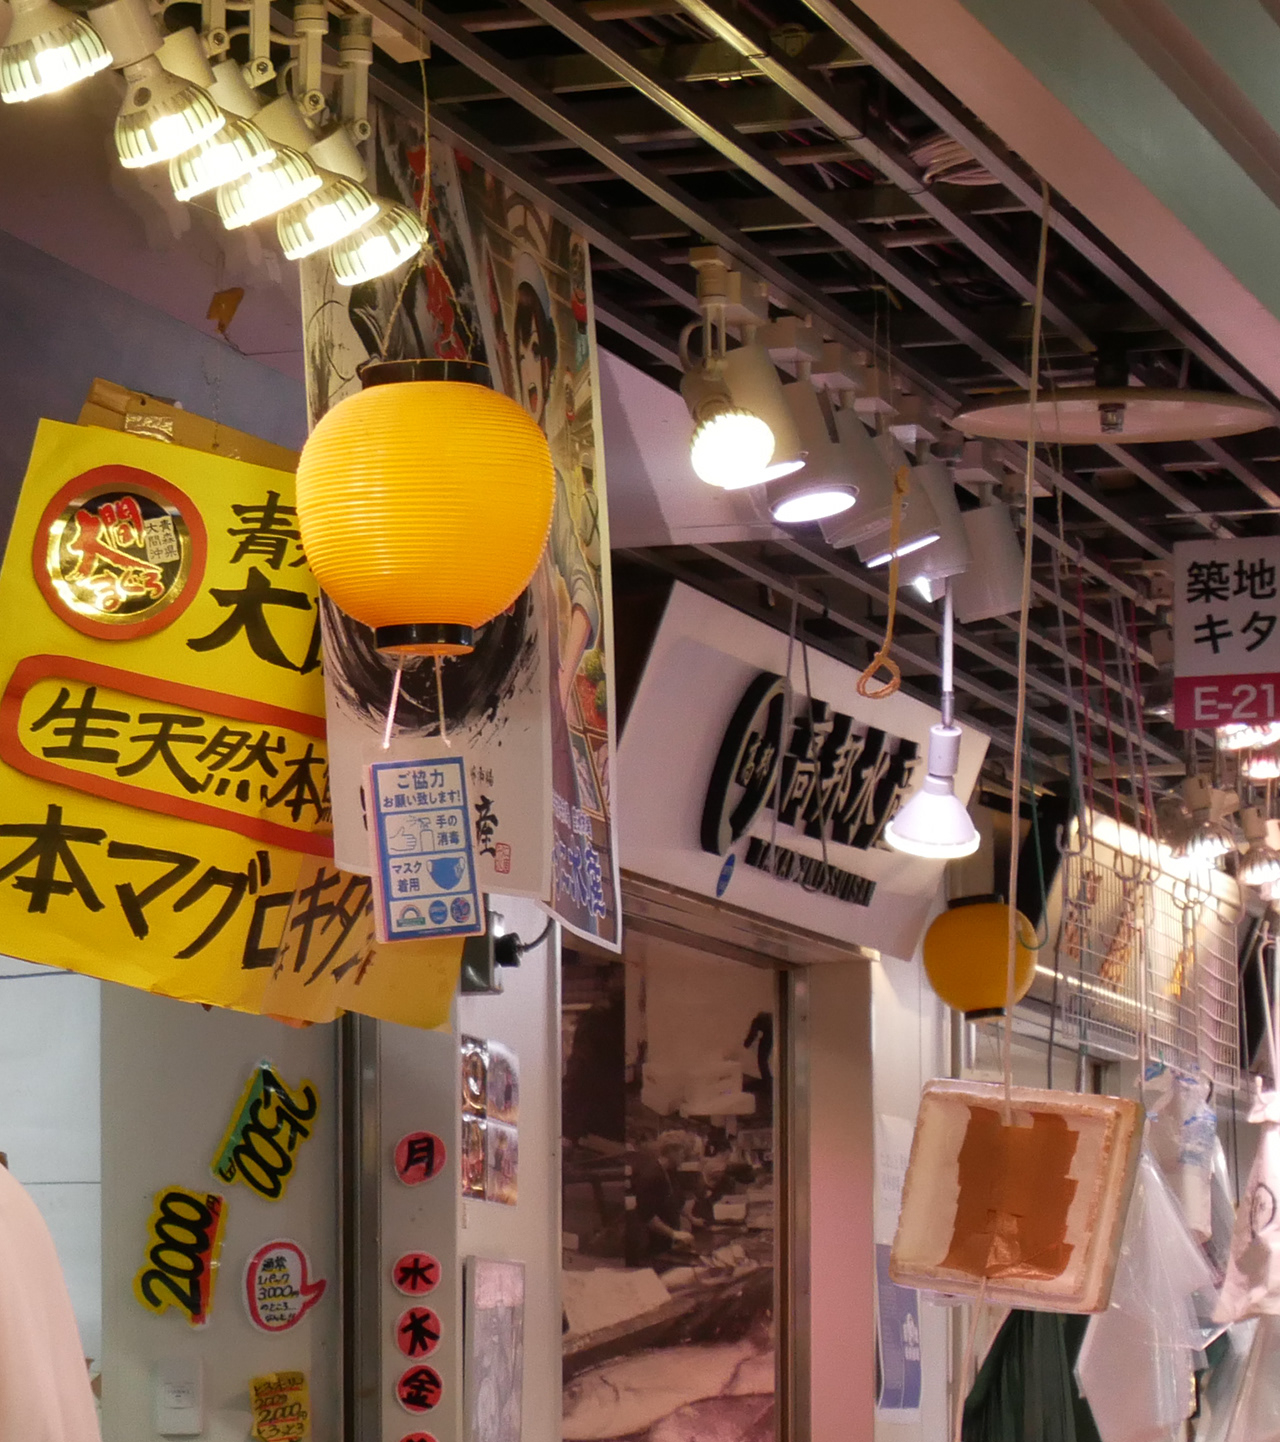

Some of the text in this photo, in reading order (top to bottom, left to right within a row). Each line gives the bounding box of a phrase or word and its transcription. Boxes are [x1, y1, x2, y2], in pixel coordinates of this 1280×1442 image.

[226, 490, 315, 572] 青
[1186, 557, 1278, 604] 築地
[186, 567, 326, 676] 大
[396, 769, 446, 791] ご協力
[382, 789, 462, 809] お願い致します!
[435, 814, 458, 827] 手の
[436, 830, 461, 846] 消毒
[391, 860, 423, 876] マスク
[396, 877, 421, 893] 着用
[401, 1138, 436, 1177] 月
[396, 1257, 436, 1291] 水
[399, 1313, 440, 1355] 木
[396, 1369, 442, 1410] 金
